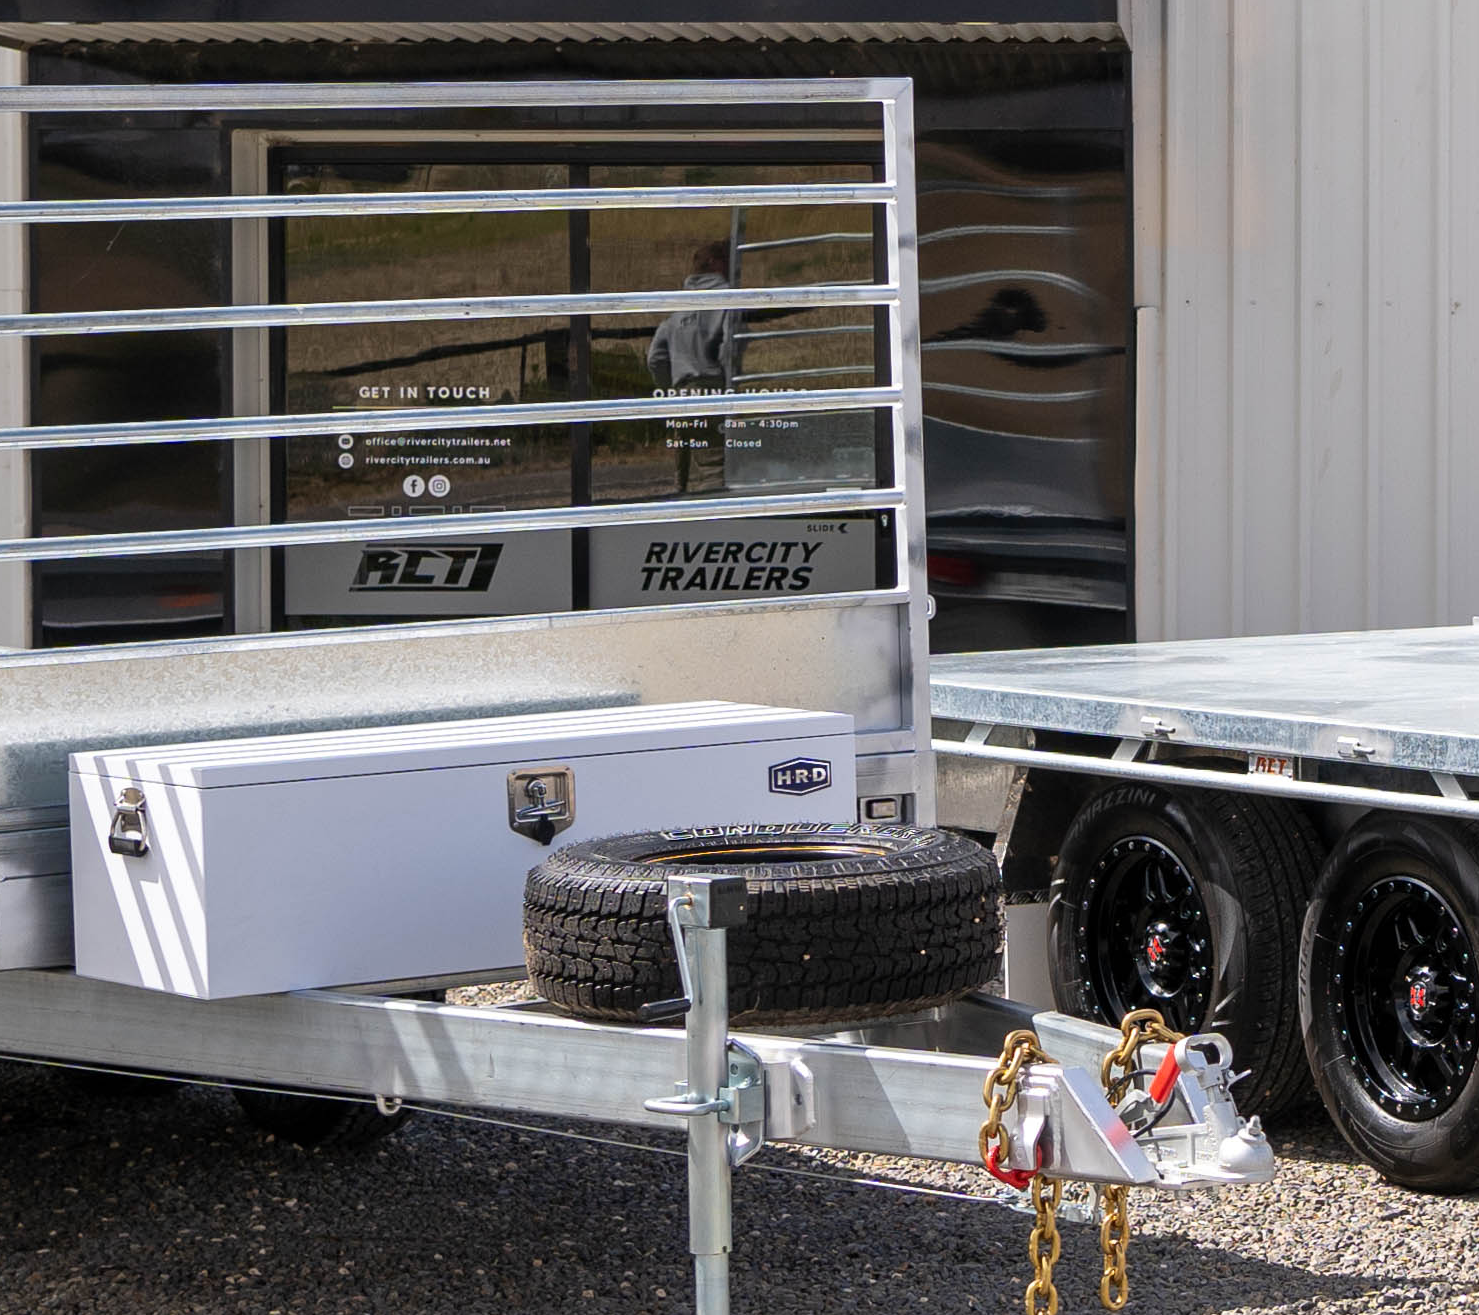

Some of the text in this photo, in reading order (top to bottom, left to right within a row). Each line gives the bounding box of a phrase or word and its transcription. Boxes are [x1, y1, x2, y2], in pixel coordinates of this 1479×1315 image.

[358, 386, 491, 399] GET IN TOUCH
[665, 419, 709, 429] Mon-Fri
[724, 419, 747, 429] 8am
[758, 419, 800, 431] 4:30pm
[365, 436, 512, 448] office@rivercitytrailers.net
[665, 438, 763, 449] Sat-Sun Closed
[365, 455, 491, 467] rivercitytrailers.com.au
[806, 524, 836, 533] SLIDE
[644, 541, 824, 564] RIVERCITY
[640, 566, 815, 591] TRAILERS
